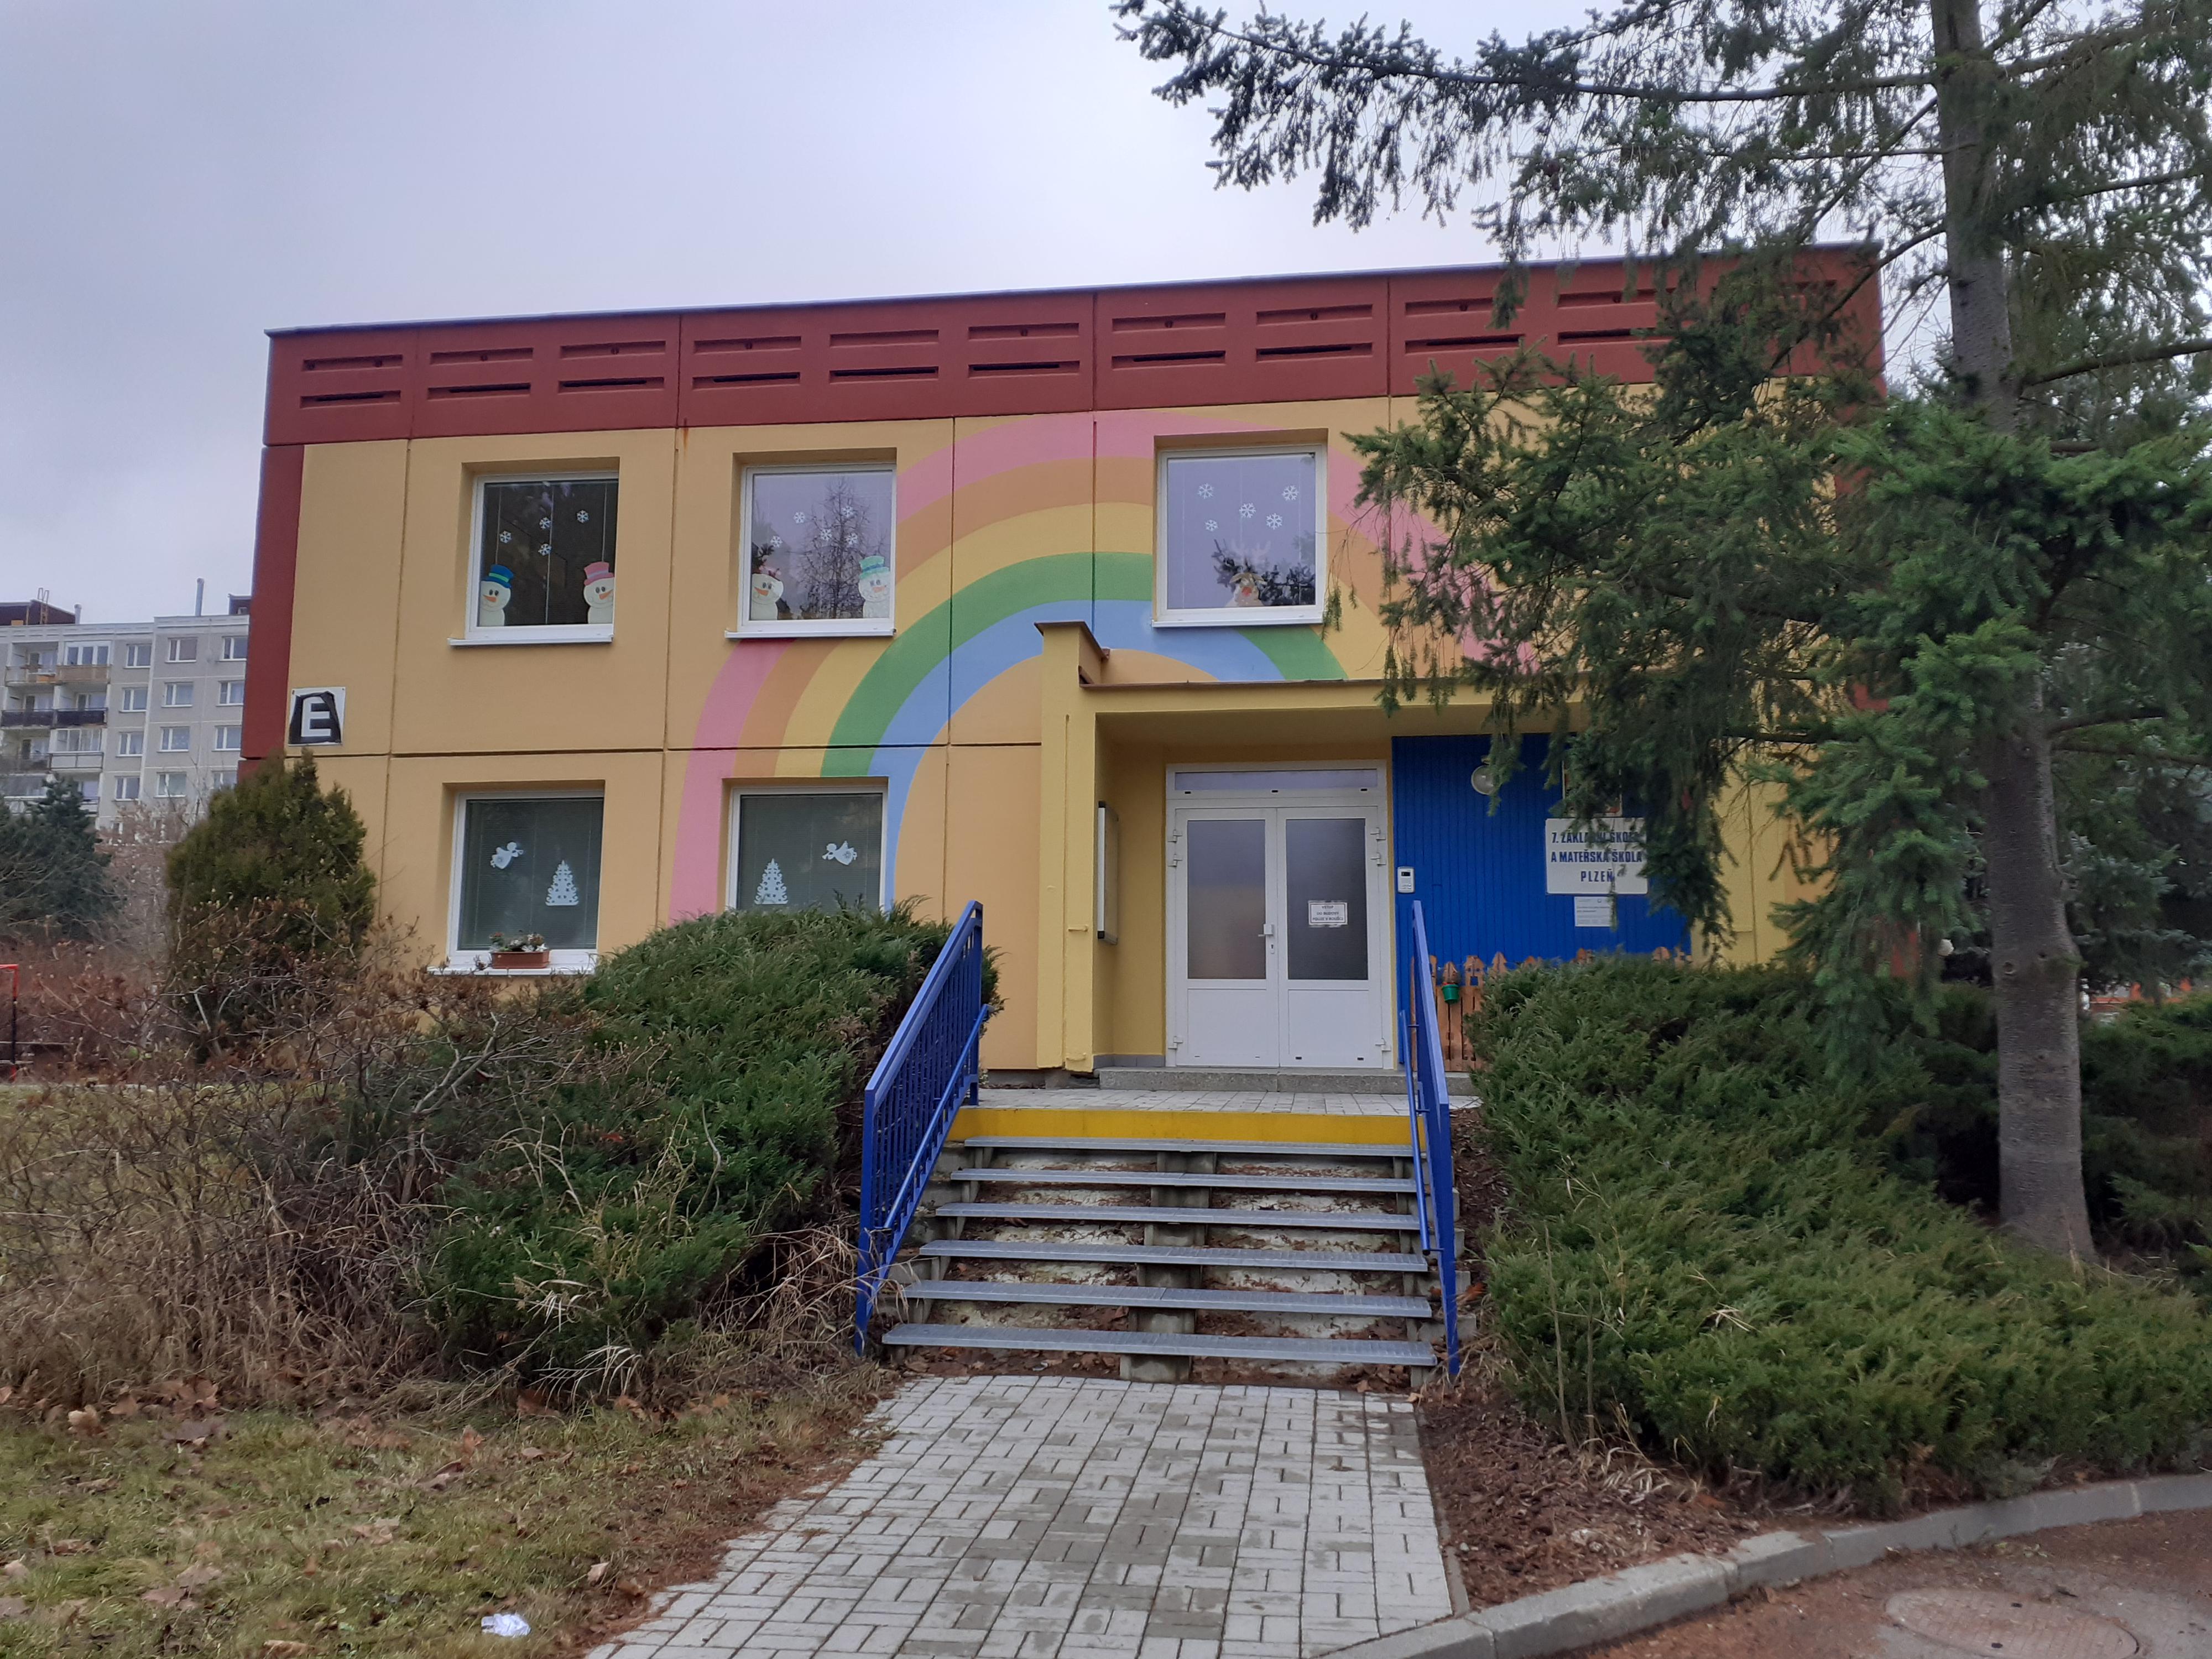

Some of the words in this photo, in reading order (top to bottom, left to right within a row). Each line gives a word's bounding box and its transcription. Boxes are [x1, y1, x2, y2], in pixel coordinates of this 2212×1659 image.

[301, 696, 332, 737] E
[1551, 832, 1559, 843] 7.
[1551, 851, 1557, 863] A
[1559, 849, 1609, 863] MATEŘSKÁ
[1611, 849, 1642, 863] ŠKOLA
[1580, 868, 1614, 882] PLZEŇ
